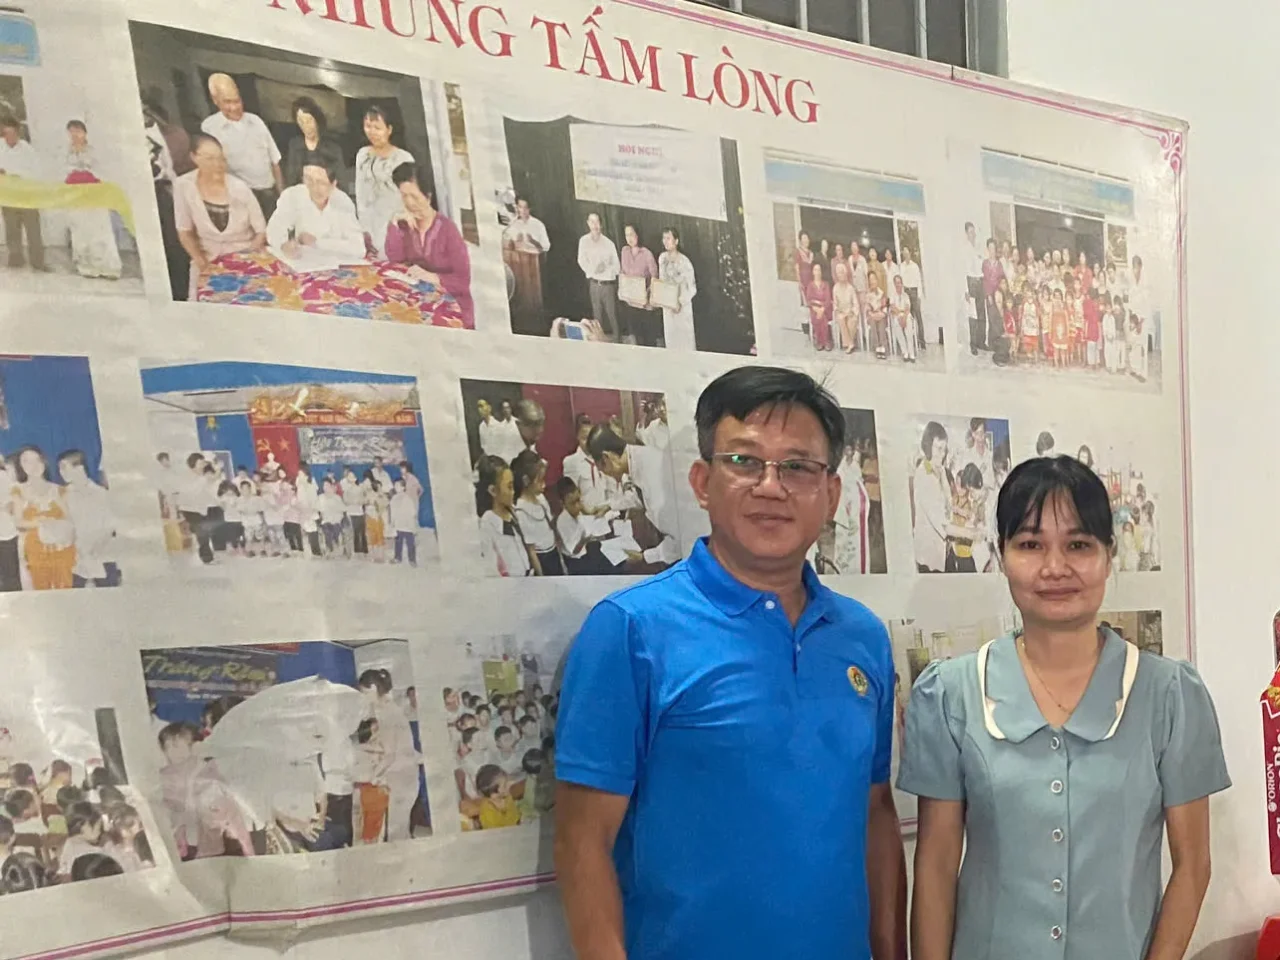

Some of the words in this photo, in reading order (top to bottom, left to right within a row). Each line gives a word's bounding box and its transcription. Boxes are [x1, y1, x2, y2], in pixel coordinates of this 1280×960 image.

[530, 5, 666, 92] TẤM
[677, 45, 820, 124] LÒNG
[1266, 763, 1276, 799] ORION
